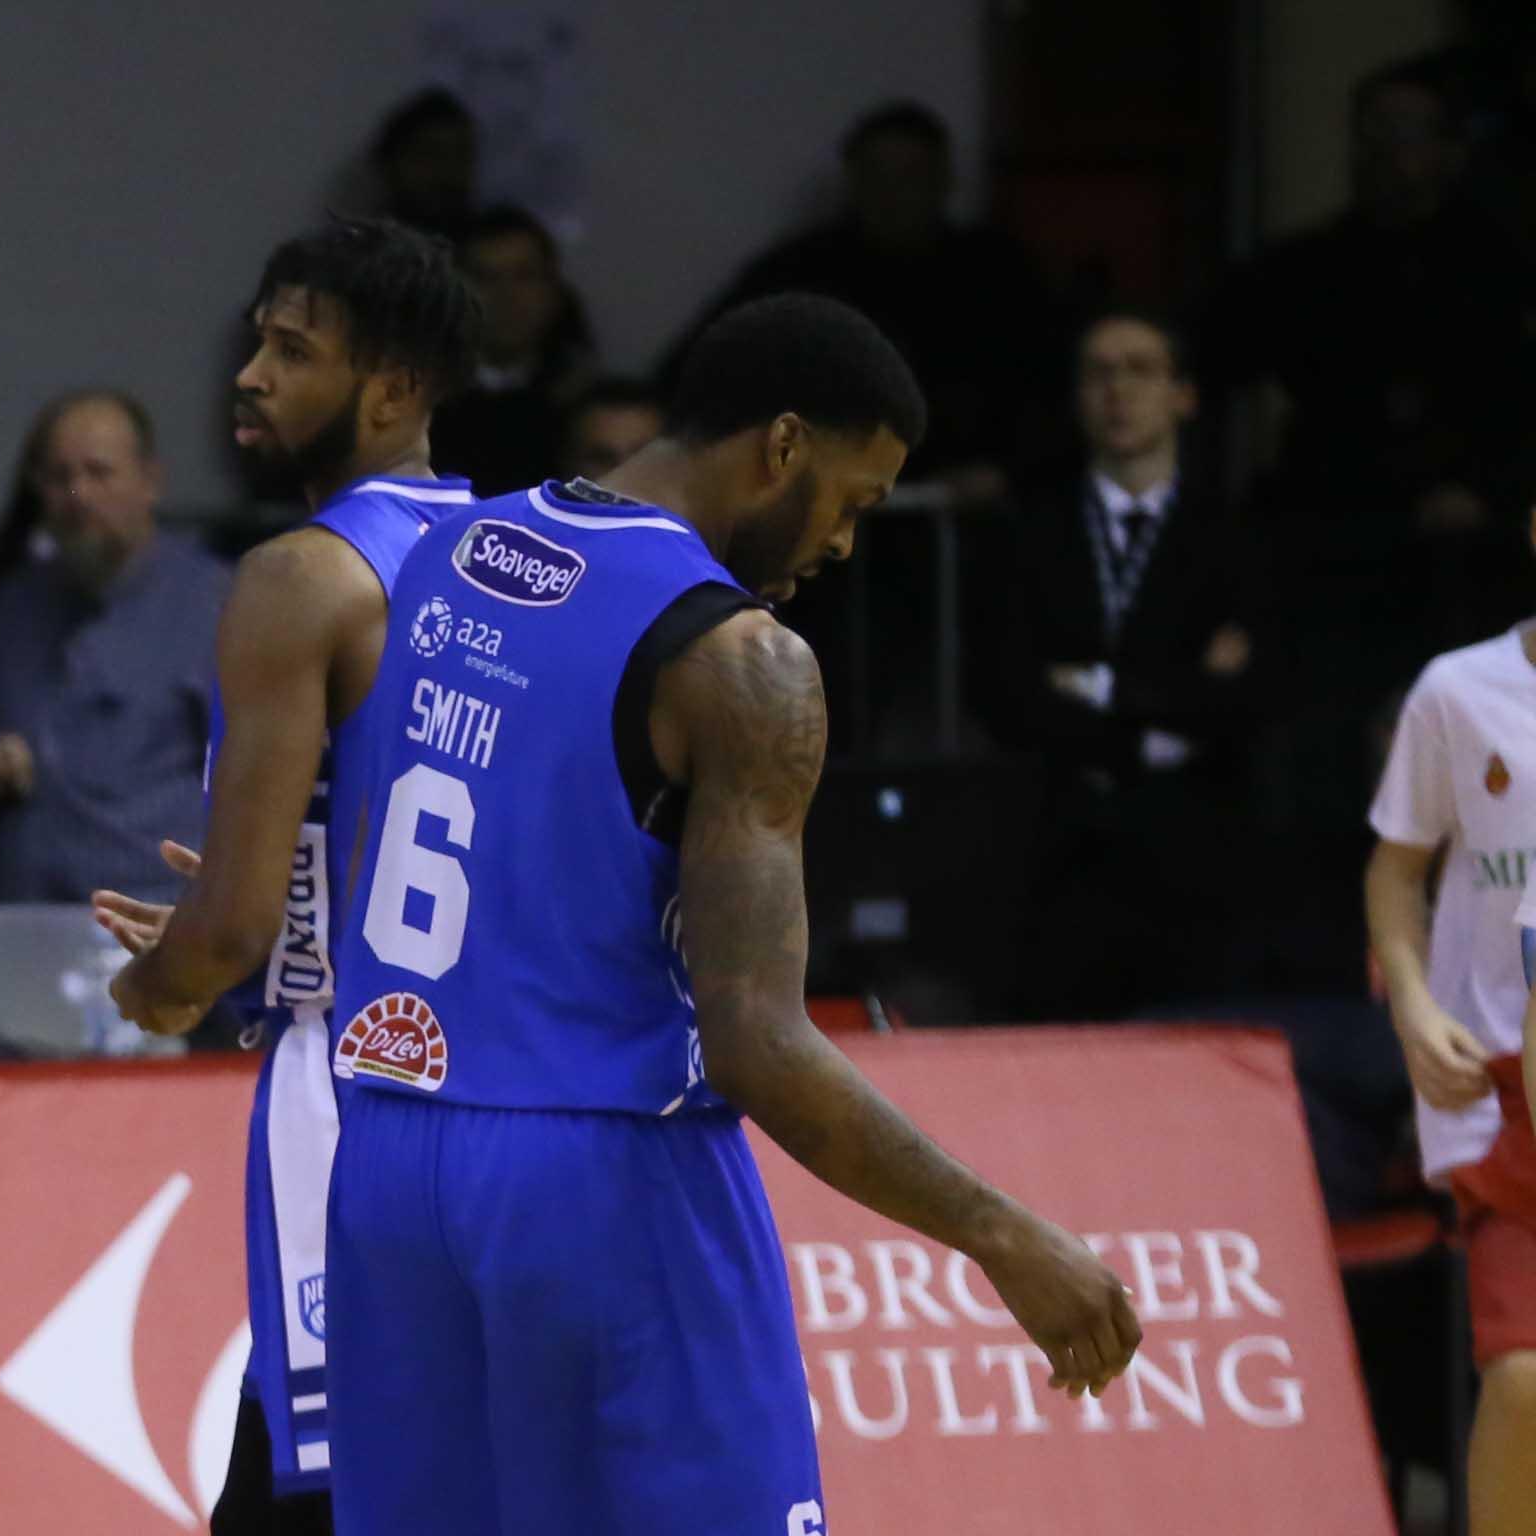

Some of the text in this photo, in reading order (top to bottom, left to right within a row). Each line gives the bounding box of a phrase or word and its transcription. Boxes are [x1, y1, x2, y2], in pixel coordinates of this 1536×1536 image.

[474, 530, 579, 595] Soavegel
[455, 617, 503, 657] a2a
[405, 677, 502, 769] SMITH
[361, 761, 476, 981] 6
